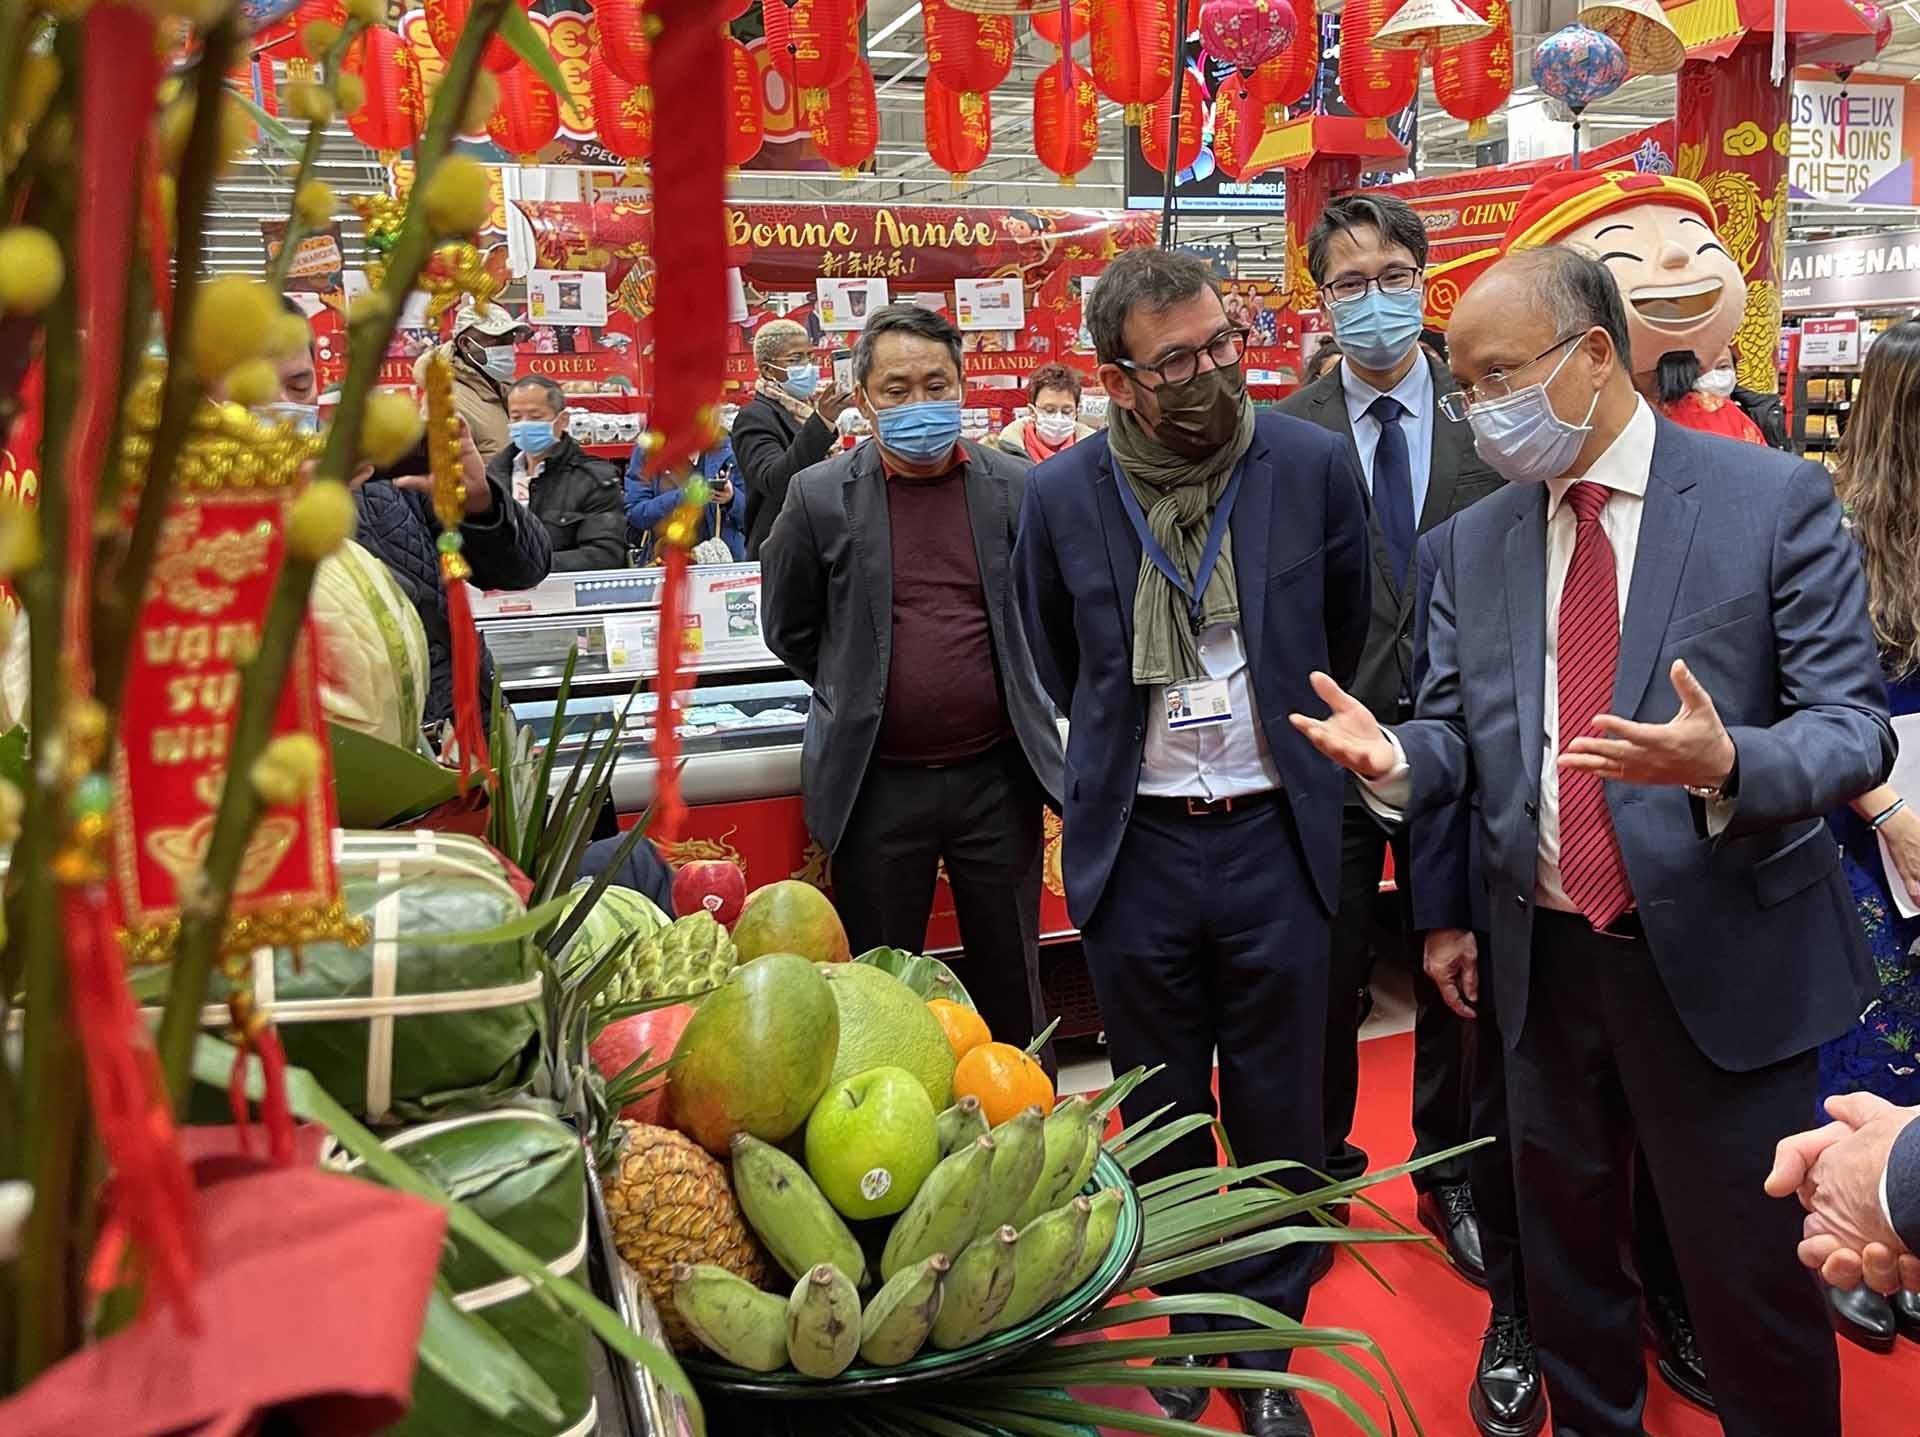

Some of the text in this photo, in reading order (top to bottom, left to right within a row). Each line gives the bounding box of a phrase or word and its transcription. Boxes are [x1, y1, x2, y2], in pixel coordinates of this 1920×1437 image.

[1790, 128, 1823, 158] ES
[1796, 162, 1870, 193] CHERS
[725, 209, 998, 248] Bonne Année
[529, 356, 597, 373] CORÉE
